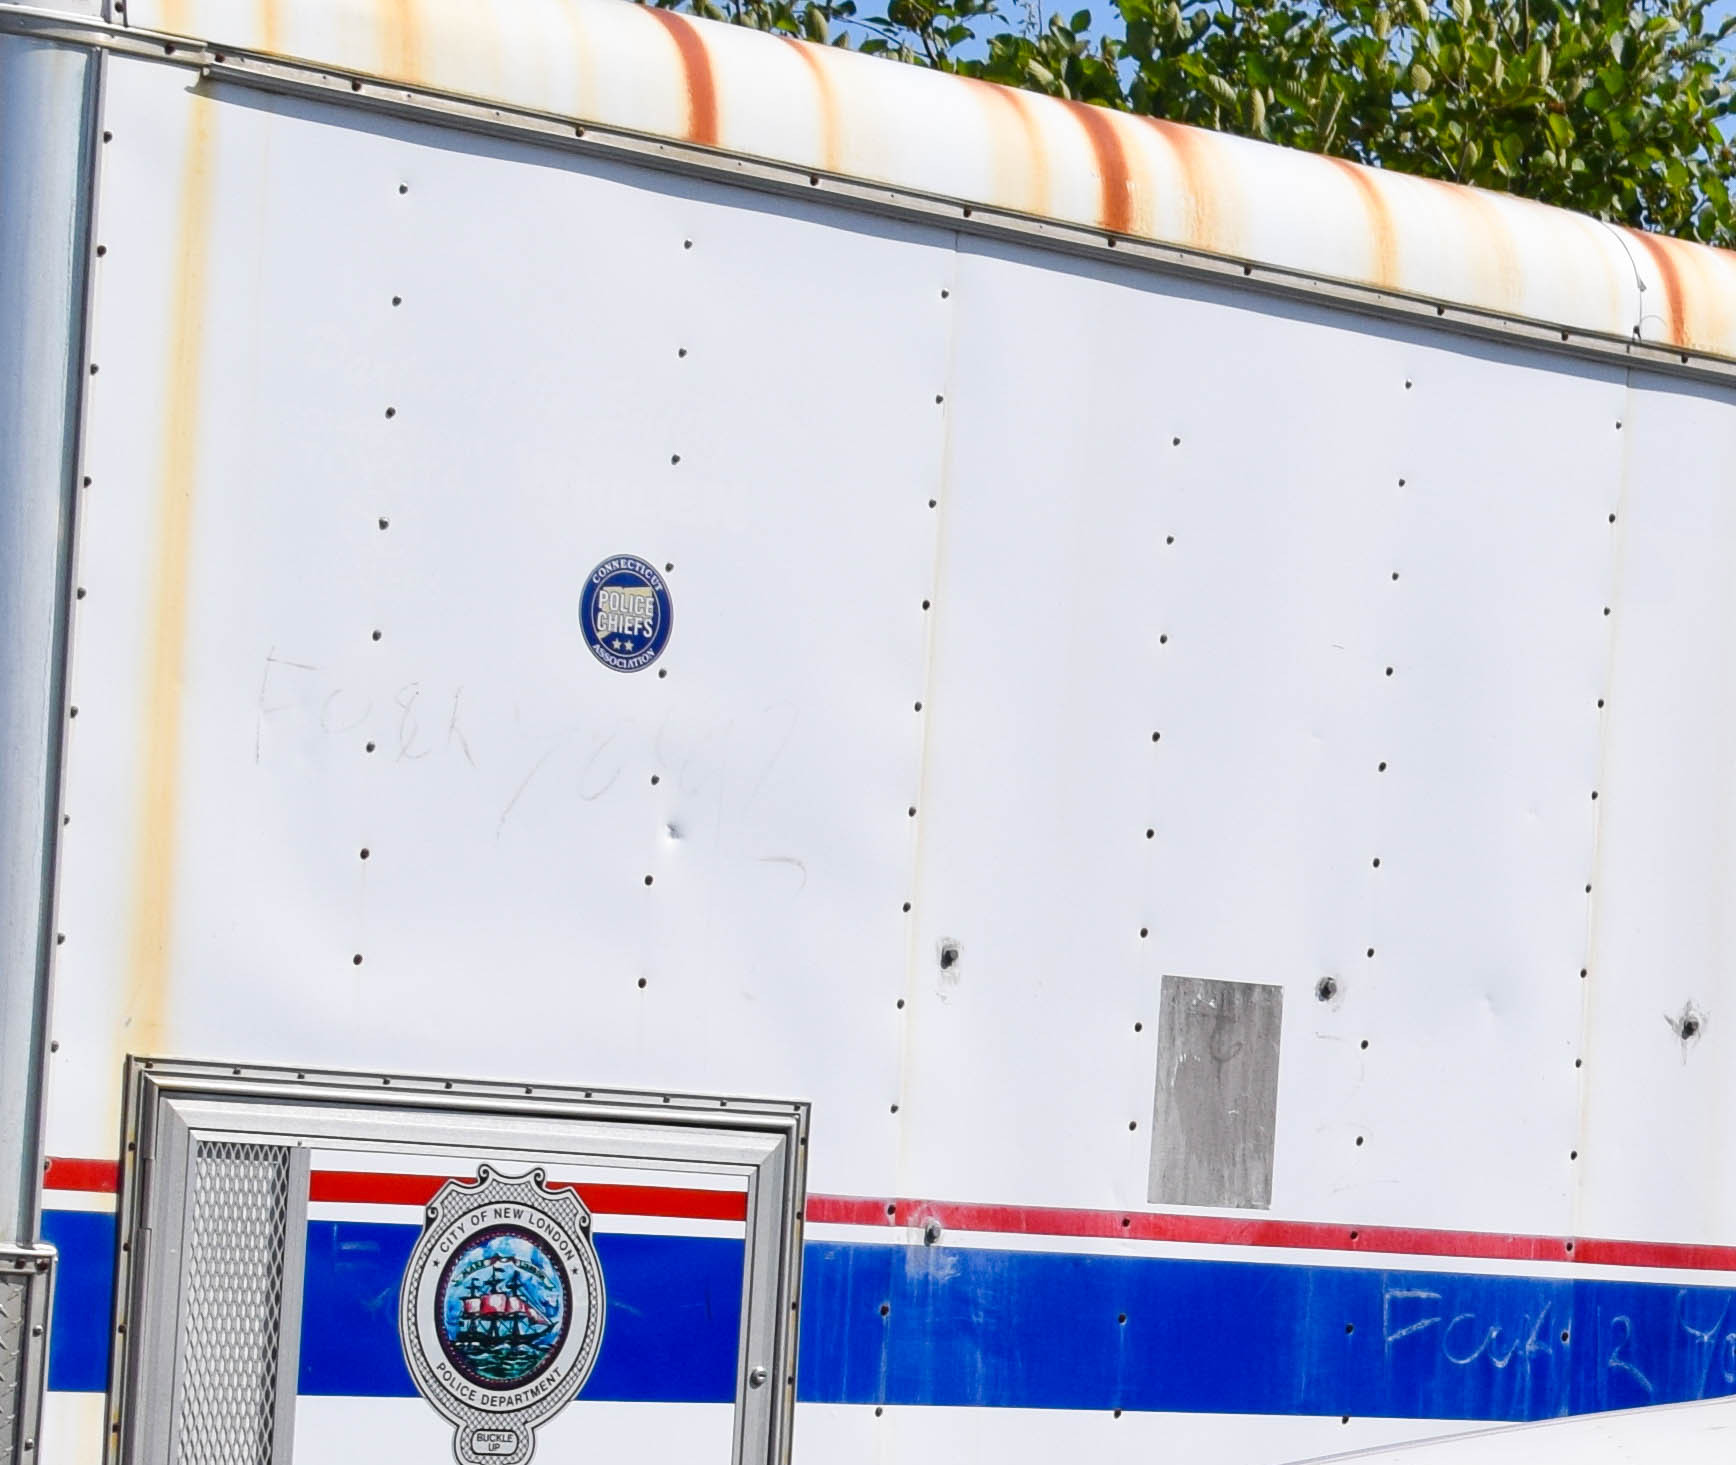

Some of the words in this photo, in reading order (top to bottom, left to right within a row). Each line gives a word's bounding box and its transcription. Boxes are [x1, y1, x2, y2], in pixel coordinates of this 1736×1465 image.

[592, 559, 663, 591] CONNECTICUT
[598, 590, 655, 617] POLICE
[597, 612, 654, 638] CHIEFS
[592, 643, 656, 668] ASSOCIATION
[439, 1223, 466, 1254] CITY
[471, 1208, 487, 1227] OF
[493, 1207, 524, 1221] NEW
[528, 1210, 575, 1262] LONDON
[436, 1362, 477, 1403] POLICE
[480, 1366, 563, 1408] DEPARTMENT
[476, 1432, 514, 1444] BUCKLE
[487, 1442, 502, 1451] UP
